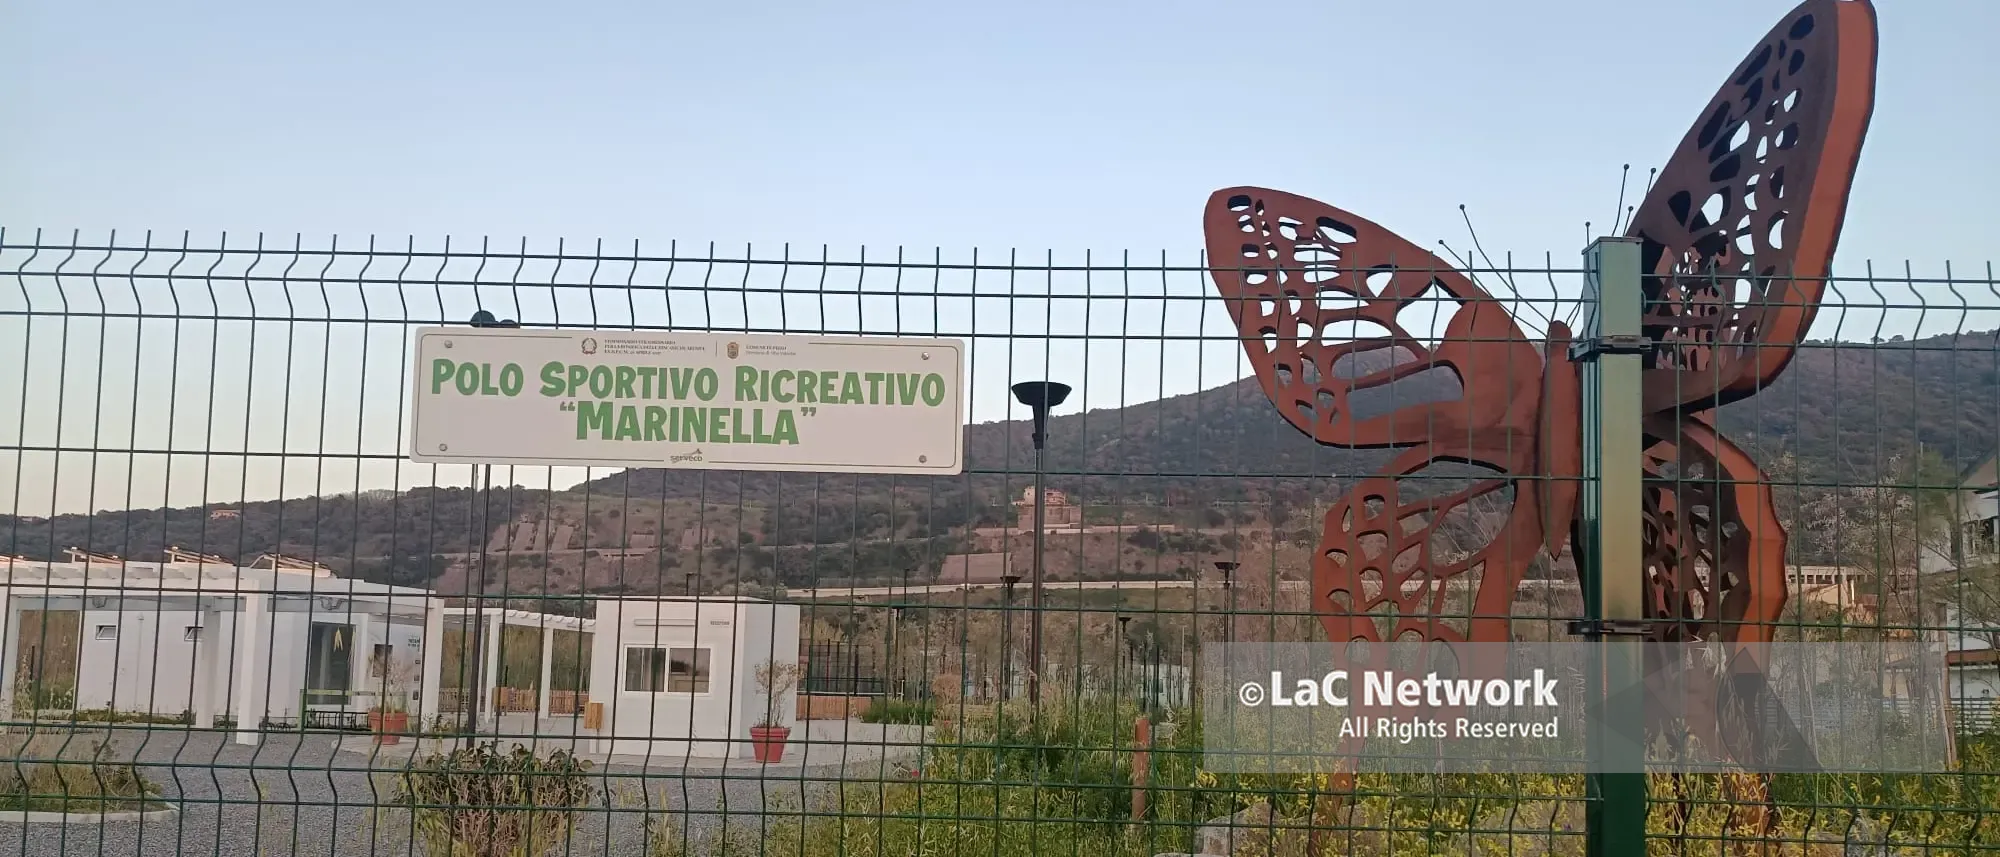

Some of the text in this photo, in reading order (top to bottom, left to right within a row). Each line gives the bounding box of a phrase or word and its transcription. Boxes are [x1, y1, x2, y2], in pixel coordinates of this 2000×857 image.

[431, 358, 946, 407] POLO SPORTIVO RICREATIVO
